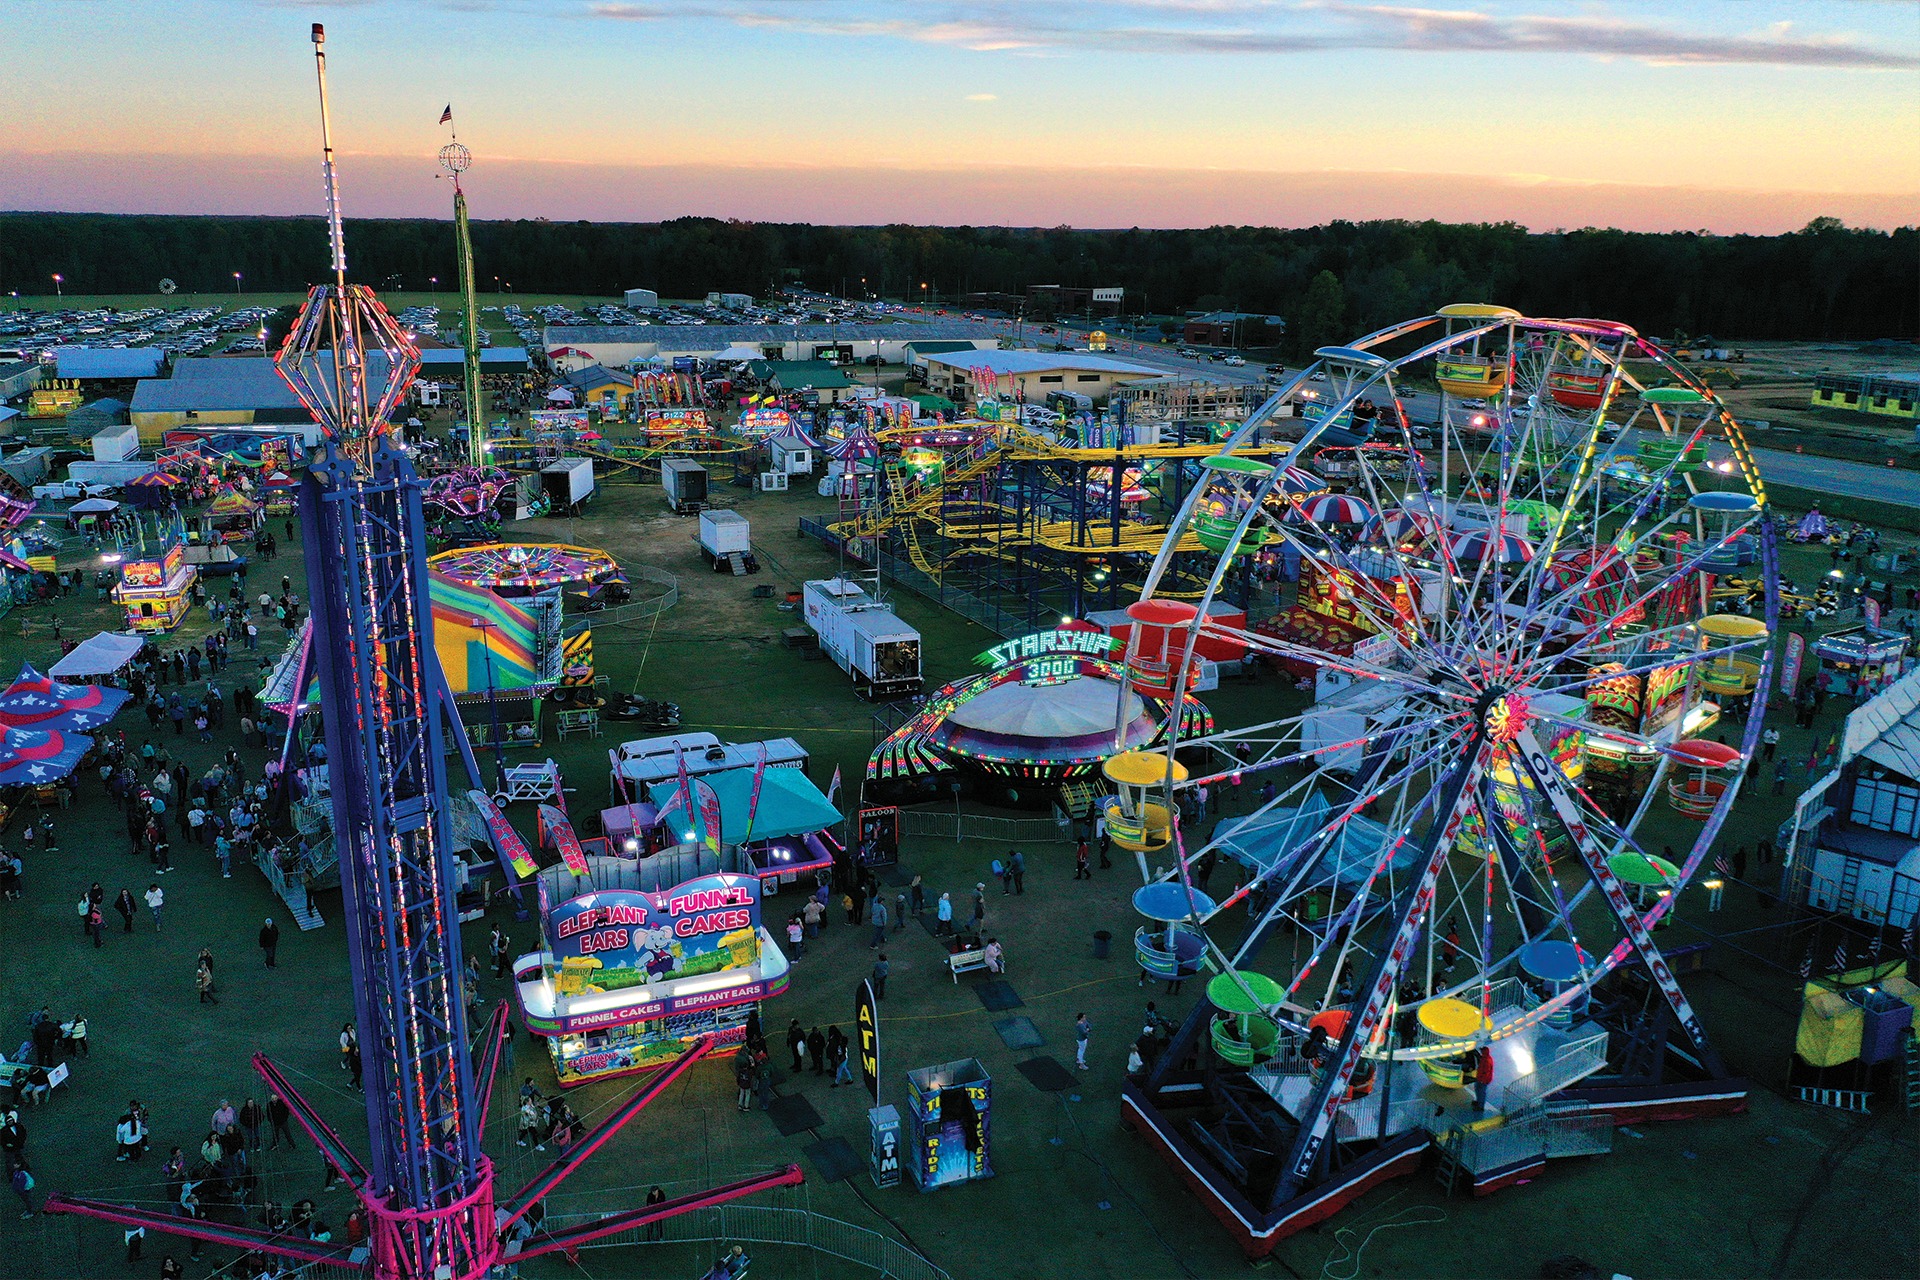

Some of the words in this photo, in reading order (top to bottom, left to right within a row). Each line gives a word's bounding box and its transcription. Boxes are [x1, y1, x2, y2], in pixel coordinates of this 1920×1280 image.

[663, 411, 692, 420] PIZZA
[988, 630, 1113, 669] STARSHIP
[1028, 660, 1074, 678] 3000
[1650, 665, 1691, 714] PIZZ
[1587, 692, 1635, 717] PIZZA
[861, 809, 895, 817] SALOON
[1532, 752, 1564, 796] OF
[1567, 820, 1687, 1009] AMERICA
[670, 886, 754, 916] FUNNEL
[558, 905, 648, 938] ELEPHANT
[675, 909, 751, 937] CAKES
[1324, 742, 1492, 1123] AMUSEMENTS
[580, 929, 628, 954] EARS
[674, 991, 730, 1008] ELEPHANT
[731, 985, 761, 998] EARS
[570, 1012, 618, 1027] FUNNEL
[619, 1004, 661, 1018] CAKES
[859, 1004, 876, 1078] ATM
[567, 1051, 619, 1068] ELEPHANT
[579, 1060, 608, 1073] EARS
[926, 1087, 986, 1112] TITS
[881, 1131, 898, 1172] ATM
[927, 1138, 939, 1173] RIDE
